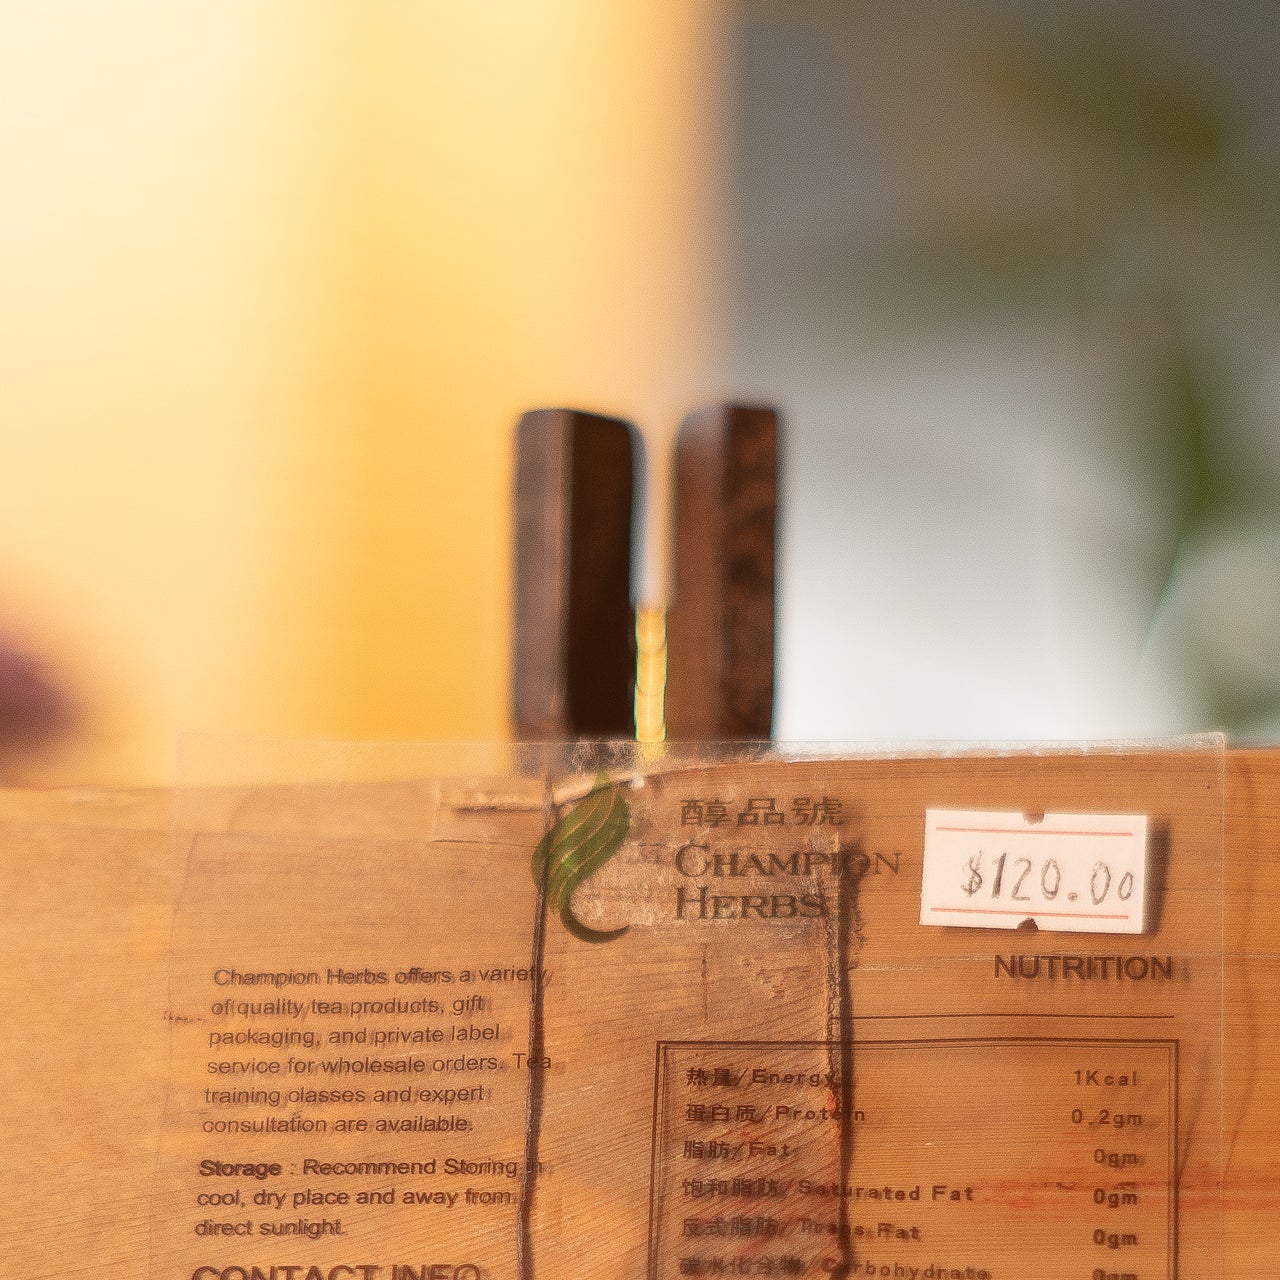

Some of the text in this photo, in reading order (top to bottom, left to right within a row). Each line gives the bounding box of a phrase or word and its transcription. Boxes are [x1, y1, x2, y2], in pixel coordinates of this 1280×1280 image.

[679, 797, 845, 828] 醇品號
[674, 839, 903, 879] CHAMPION
[960, 848, 1136, 907] $120.00
[674, 886, 824, 922] HERBS
[213, 965, 549, 988] Champion Herbs offers a variety
[992, 954, 1173, 982] NUTRITION
[211, 995, 485, 1019] of quality tea products, gift
[208, 1024, 501, 1049] packaging, and private label
[206, 1052, 553, 1075] service for wholesale orders. Tea
[1073, 1069, 1139, 1088] 1Kcal
[204, 1084, 486, 1107] training classes and expert
[202, 1113, 474, 1134] consultation are available.
[685, 1103, 866, 1124] 蛋白质/Proten
[198, 1158, 283, 1180] Storage
[302, 1157, 438, 1176] Recommend
[443, 1157, 518, 1179] Storing
[1093, 1147, 1140, 1168] 0gm
[196, 1187, 512, 1209] cool, dry place and away from
[930, 1185, 975, 1202] Fat
[1092, 1187, 1139, 1209] 0gm
[194, 1217, 345, 1240] direct sunlight.
[876, 1221, 922, 1240] Fat
[1092, 1228, 1139, 1250] 0gm
